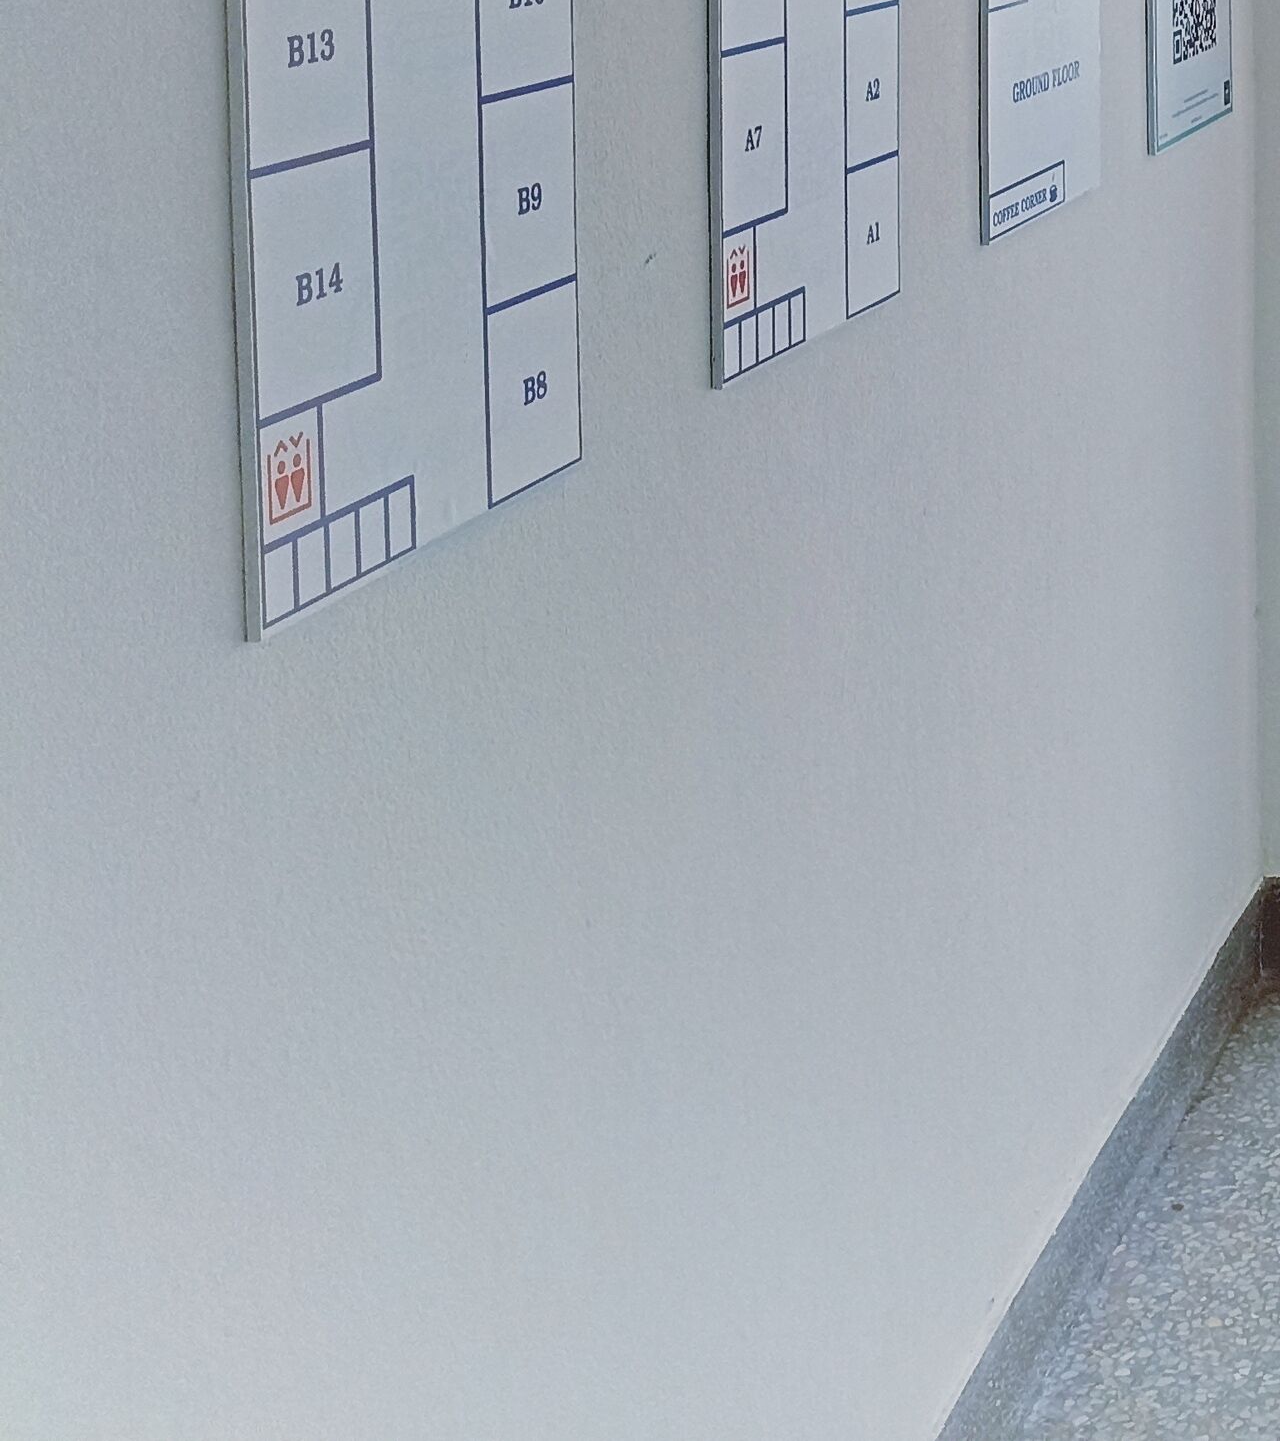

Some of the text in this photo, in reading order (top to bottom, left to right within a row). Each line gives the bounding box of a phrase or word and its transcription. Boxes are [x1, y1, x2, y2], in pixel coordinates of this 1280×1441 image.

[286, 28, 336, 69] B13
[865, 77, 881, 102] A2
[1012, 60, 1081, 103] GROUND FLOOR
[744, 125, 763, 152] A7
[516, 182, 543, 216] B9
[992, 187, 1047, 227] COFFEE CORNER
[866, 221, 881, 245] A1
[295, 262, 344, 306] B14
[522, 370, 549, 406] B8
